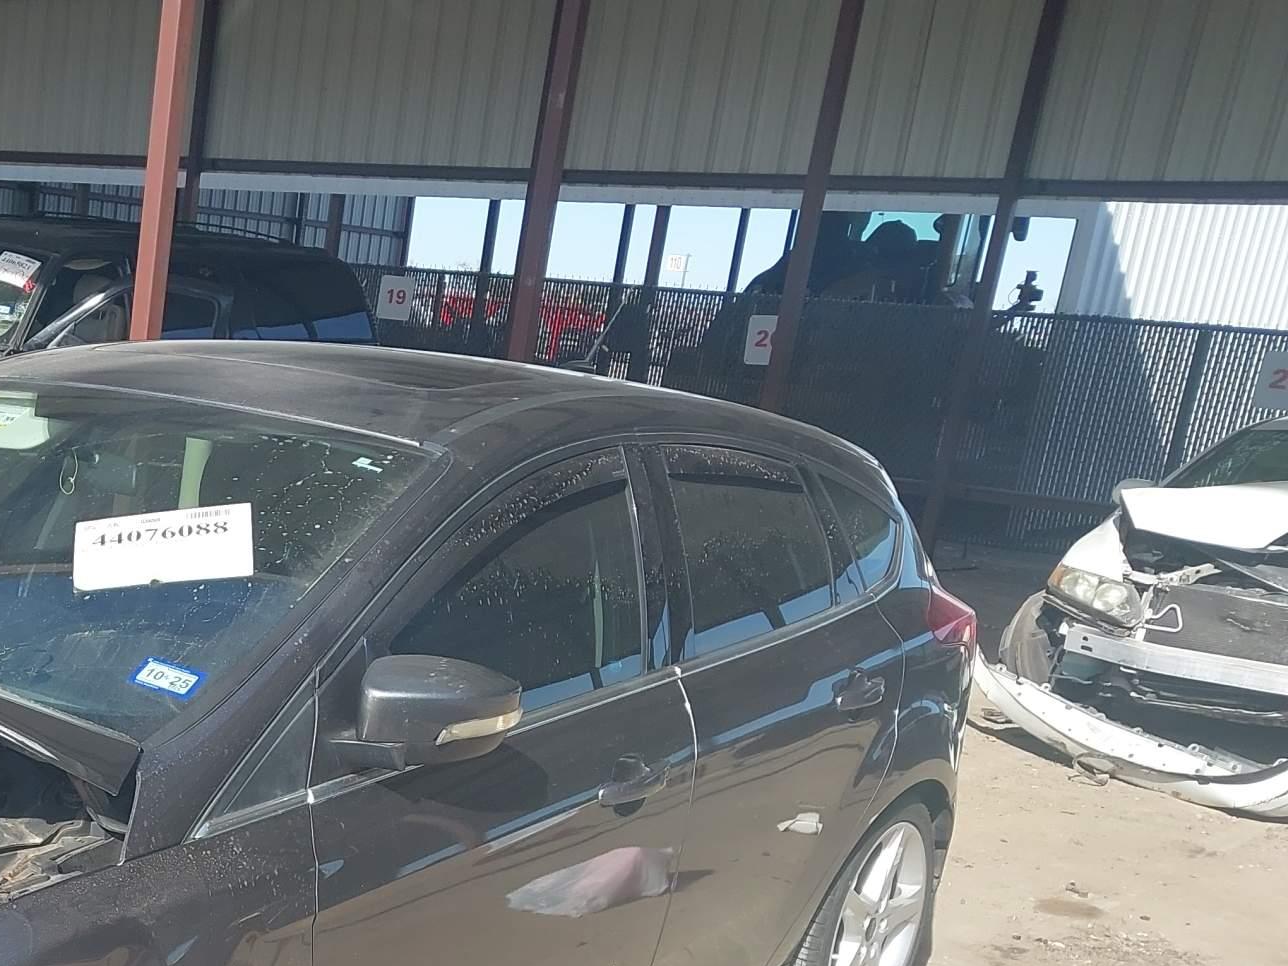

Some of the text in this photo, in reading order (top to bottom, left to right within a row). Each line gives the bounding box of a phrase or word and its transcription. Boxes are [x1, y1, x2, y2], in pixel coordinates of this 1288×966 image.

[386, 289, 407, 305] 19
[754, 329, 773, 347] 2
[91, 521, 229, 546] 44076088
[145, 668, 165, 681] 10
[169, 676, 193, 689] 25
